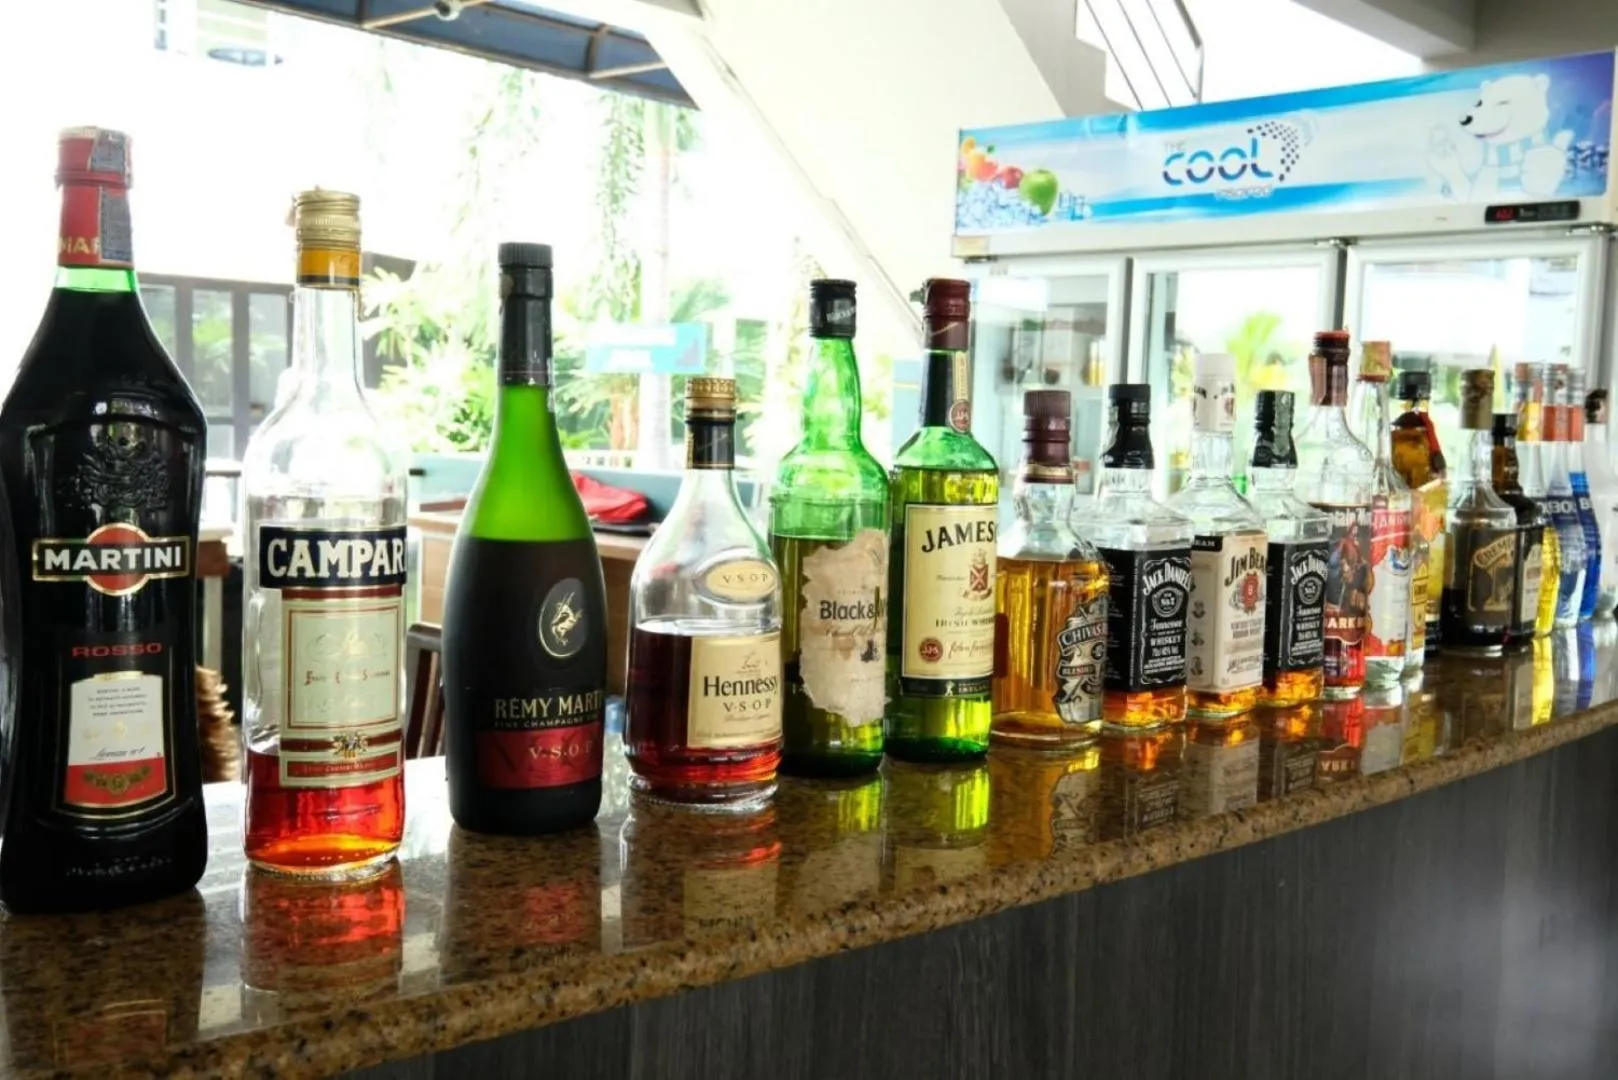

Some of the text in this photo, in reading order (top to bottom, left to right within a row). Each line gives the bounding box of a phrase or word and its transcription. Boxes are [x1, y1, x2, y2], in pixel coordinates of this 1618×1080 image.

[44, 546, 181, 571] MARTINI
[1142, 568, 1165, 596] JACK
[1224, 556, 1248, 587] JIM
[1326, 616, 1357, 630] ARK
[72, 642, 163, 658] ROSSO
[703, 674, 778, 698] Hennessy
[495, 697, 553, 720] RÉMY
